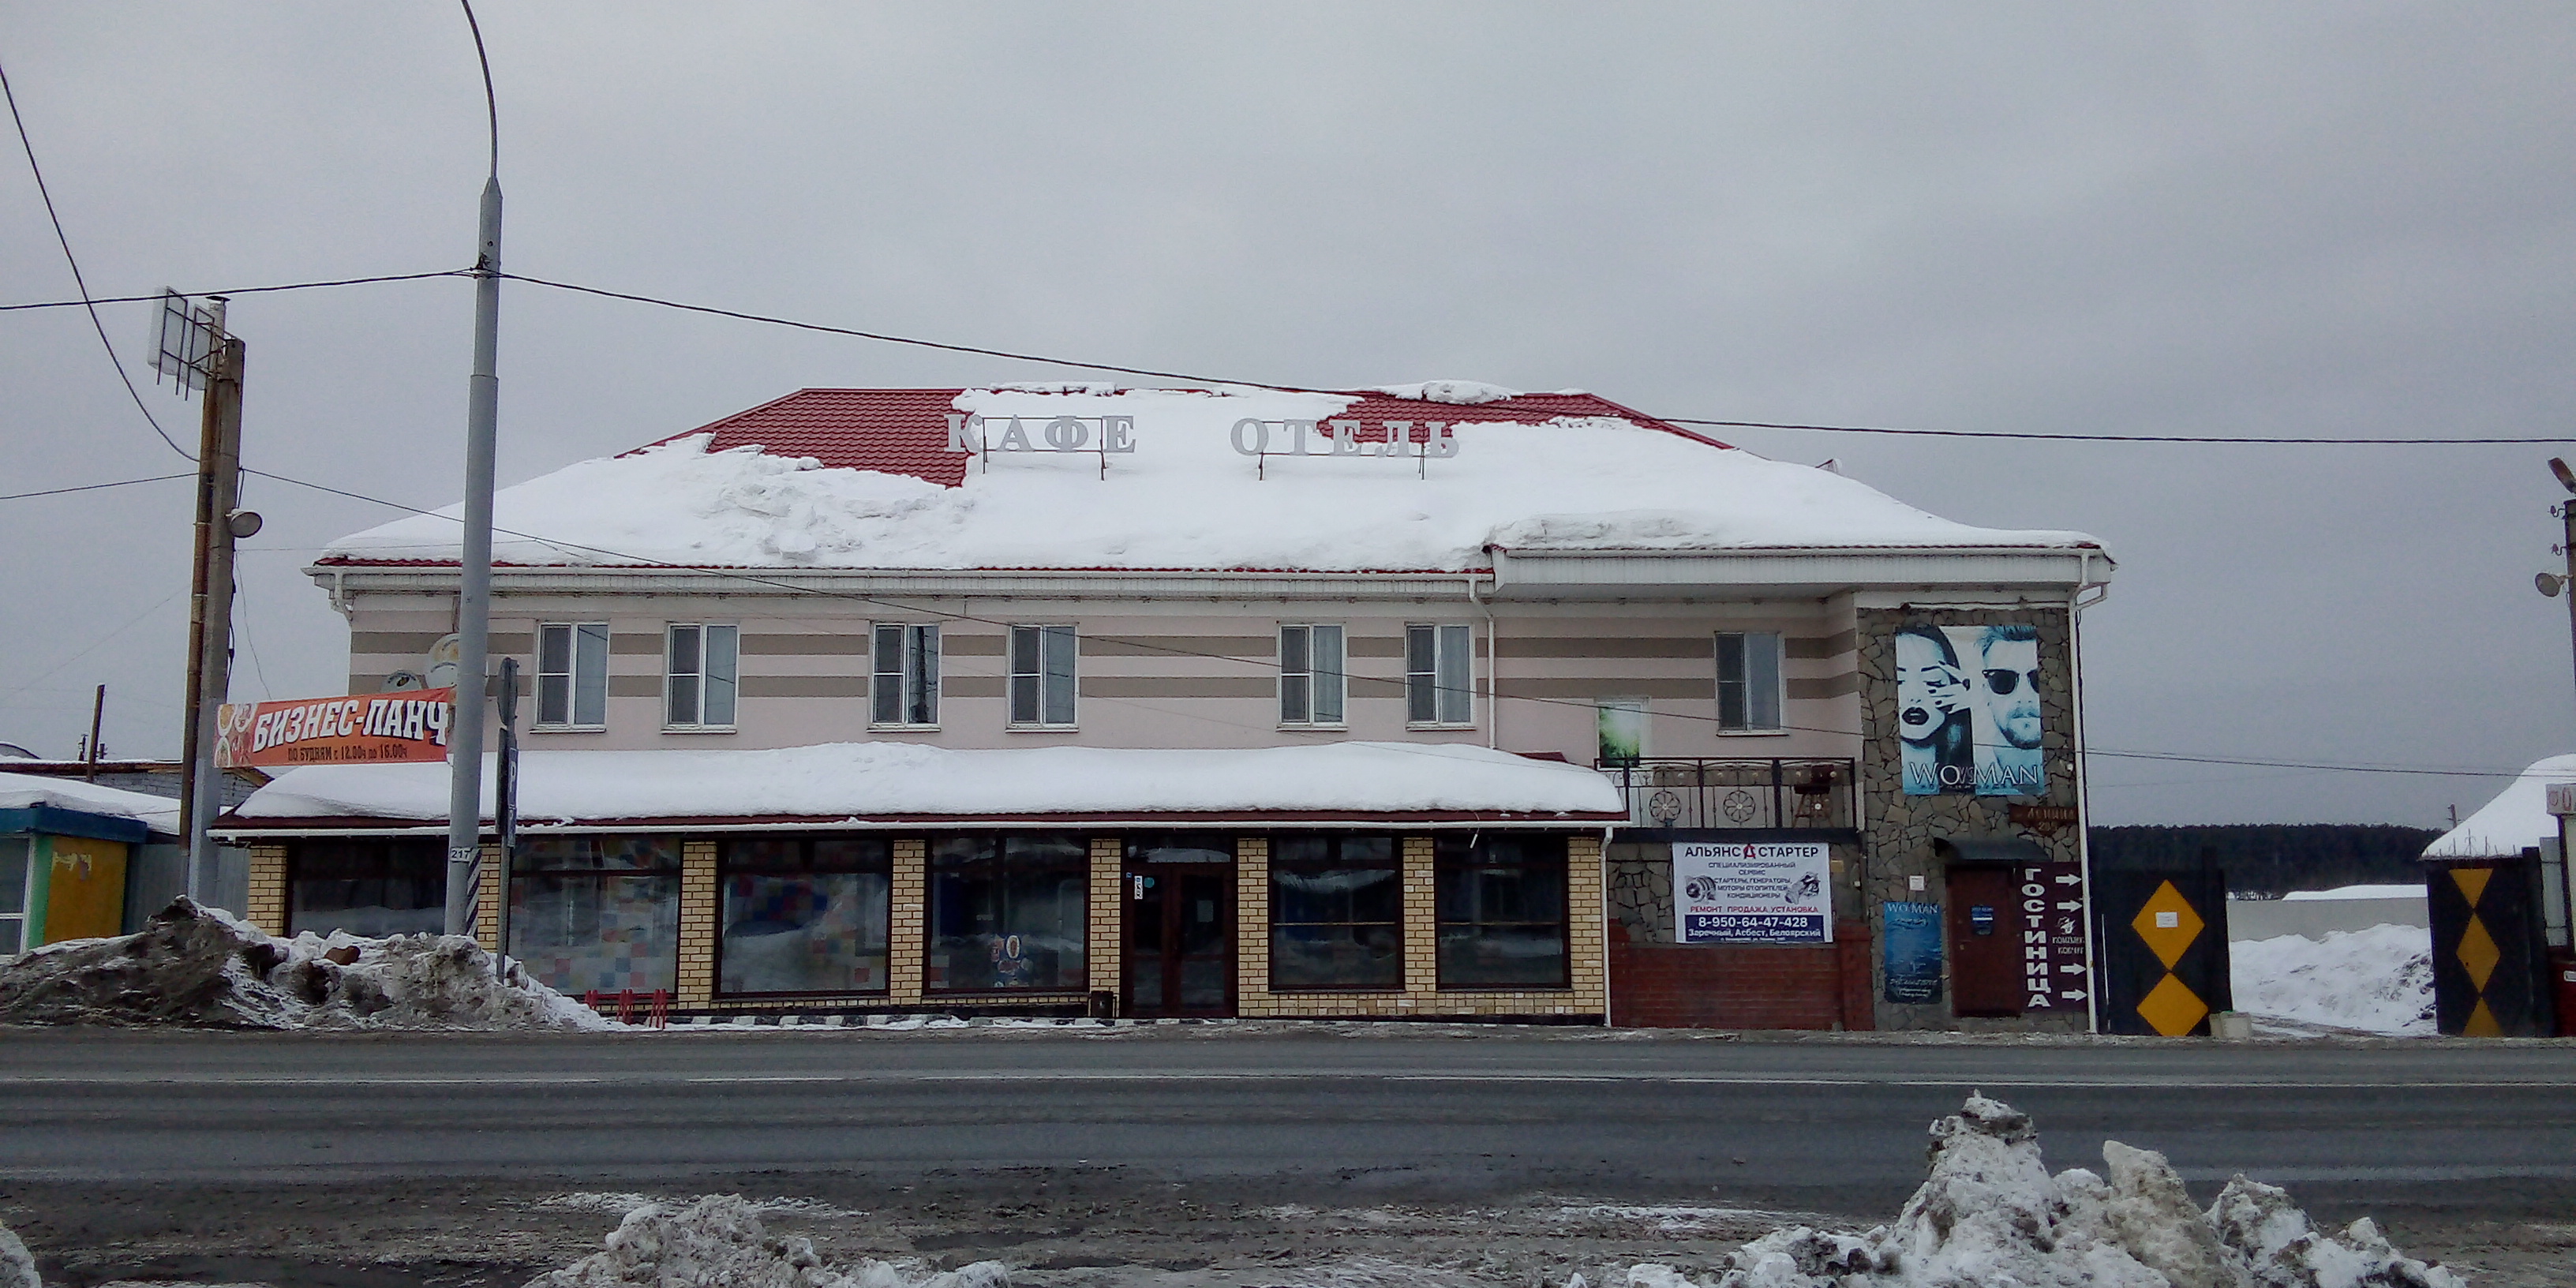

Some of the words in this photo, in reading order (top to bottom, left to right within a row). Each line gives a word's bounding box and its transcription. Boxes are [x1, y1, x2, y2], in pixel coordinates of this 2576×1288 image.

[944, 414, 1136, 453] КАФЕ
[1230, 417, 1459, 458] ОТЕЛЬ
[253, 699, 449, 752] БИЗНЕС-ЛАНЧ
[288, 747, 298, 761] ПО
[300, 747, 331, 762] БУДНЯМ
[451, 850, 470, 859] 217
[1685, 847, 1741, 858] АЛЬЯНС
[1758, 847, 1818, 858] СТАРТЕР
[1698, 917, 1808, 928] 8-950-64-47-428
[1735, 929, 1769, 938] Асбест,
[2021, 868, 2052, 1008] ГОСТИНИЦА
